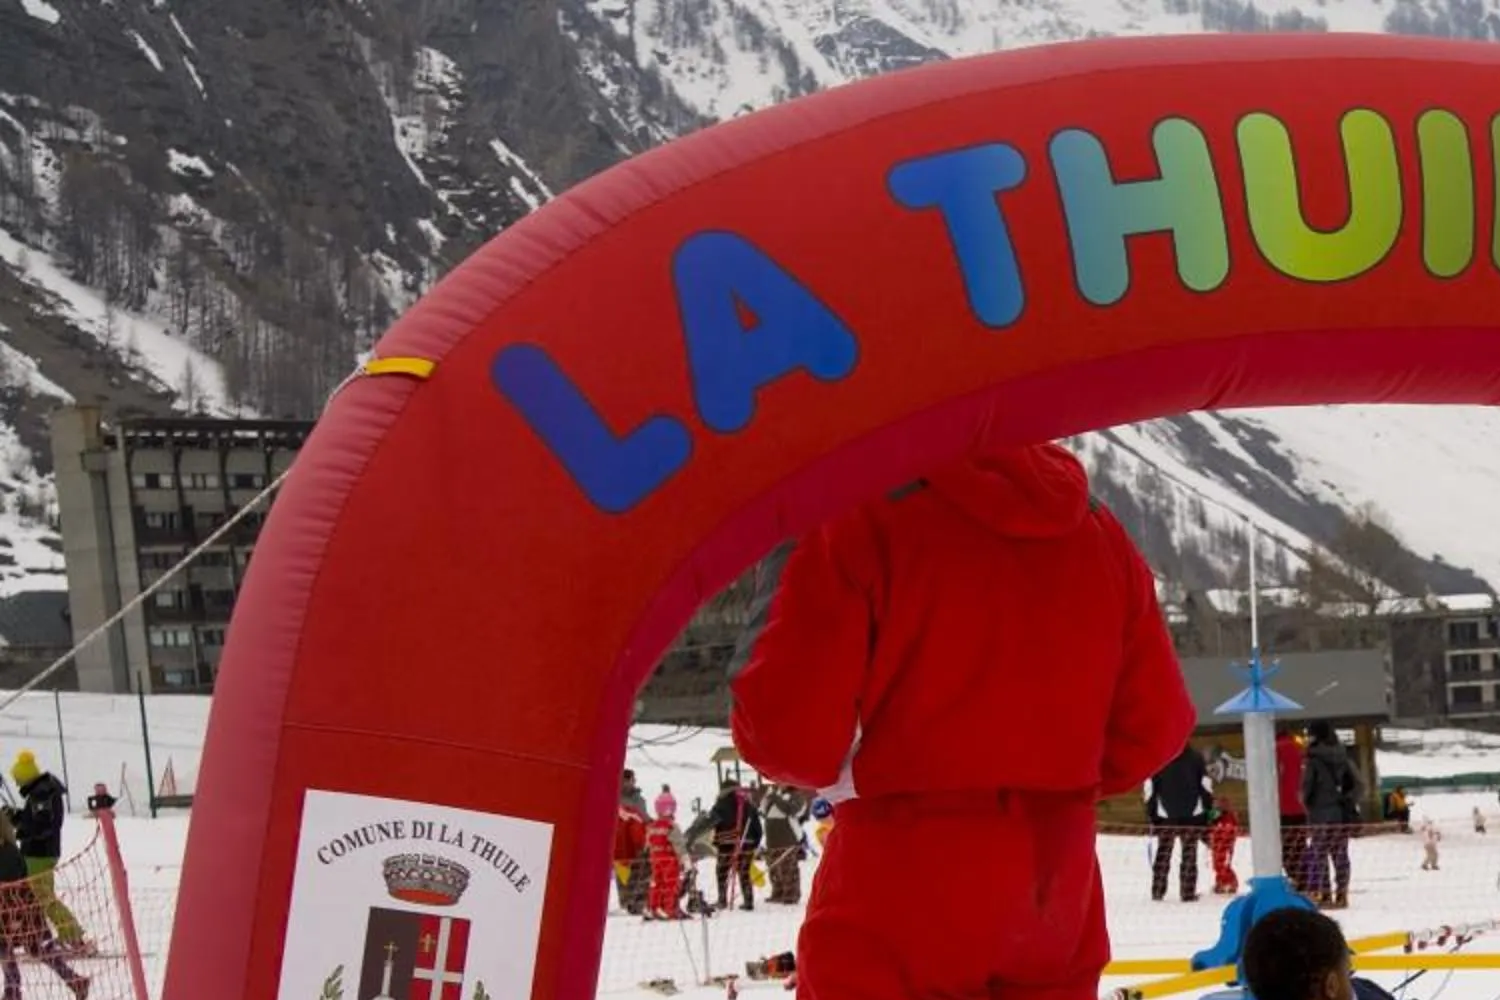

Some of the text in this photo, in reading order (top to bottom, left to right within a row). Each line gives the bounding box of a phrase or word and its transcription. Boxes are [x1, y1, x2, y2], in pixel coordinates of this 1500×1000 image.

[490, 229, 859, 513] LA
[317, 820, 531, 894] COMUNE DI LA THUILE
